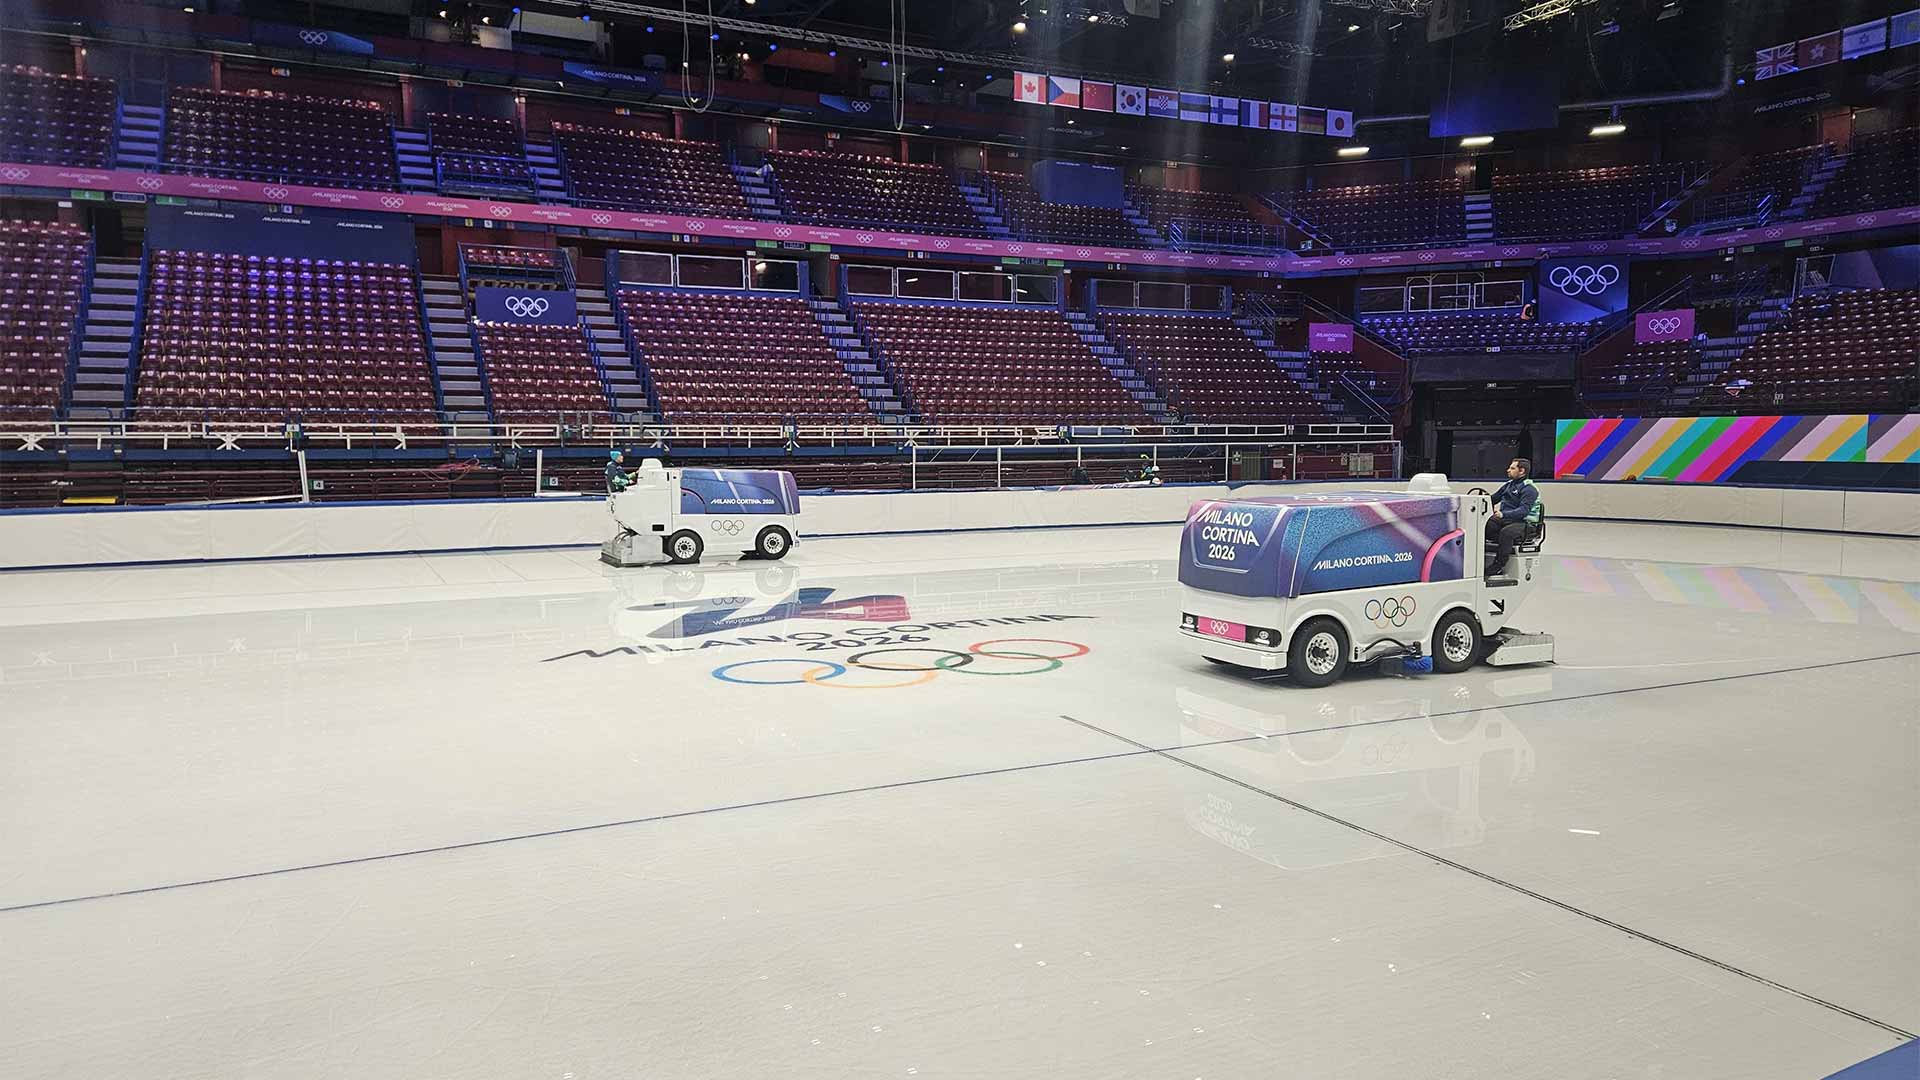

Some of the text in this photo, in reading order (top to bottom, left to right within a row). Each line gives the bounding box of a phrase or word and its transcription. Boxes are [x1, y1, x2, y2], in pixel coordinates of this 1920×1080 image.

[1197, 509, 1253, 527] MILANO
[1202, 526, 1260, 547] CORTINA
[1208, 543, 1236, 561] 2026
[1313, 551, 1413, 571] MILANO CORTINA 2026
[539, 613, 1097, 663] MILANO CORTINA
[796, 633, 931, 652] 2026
